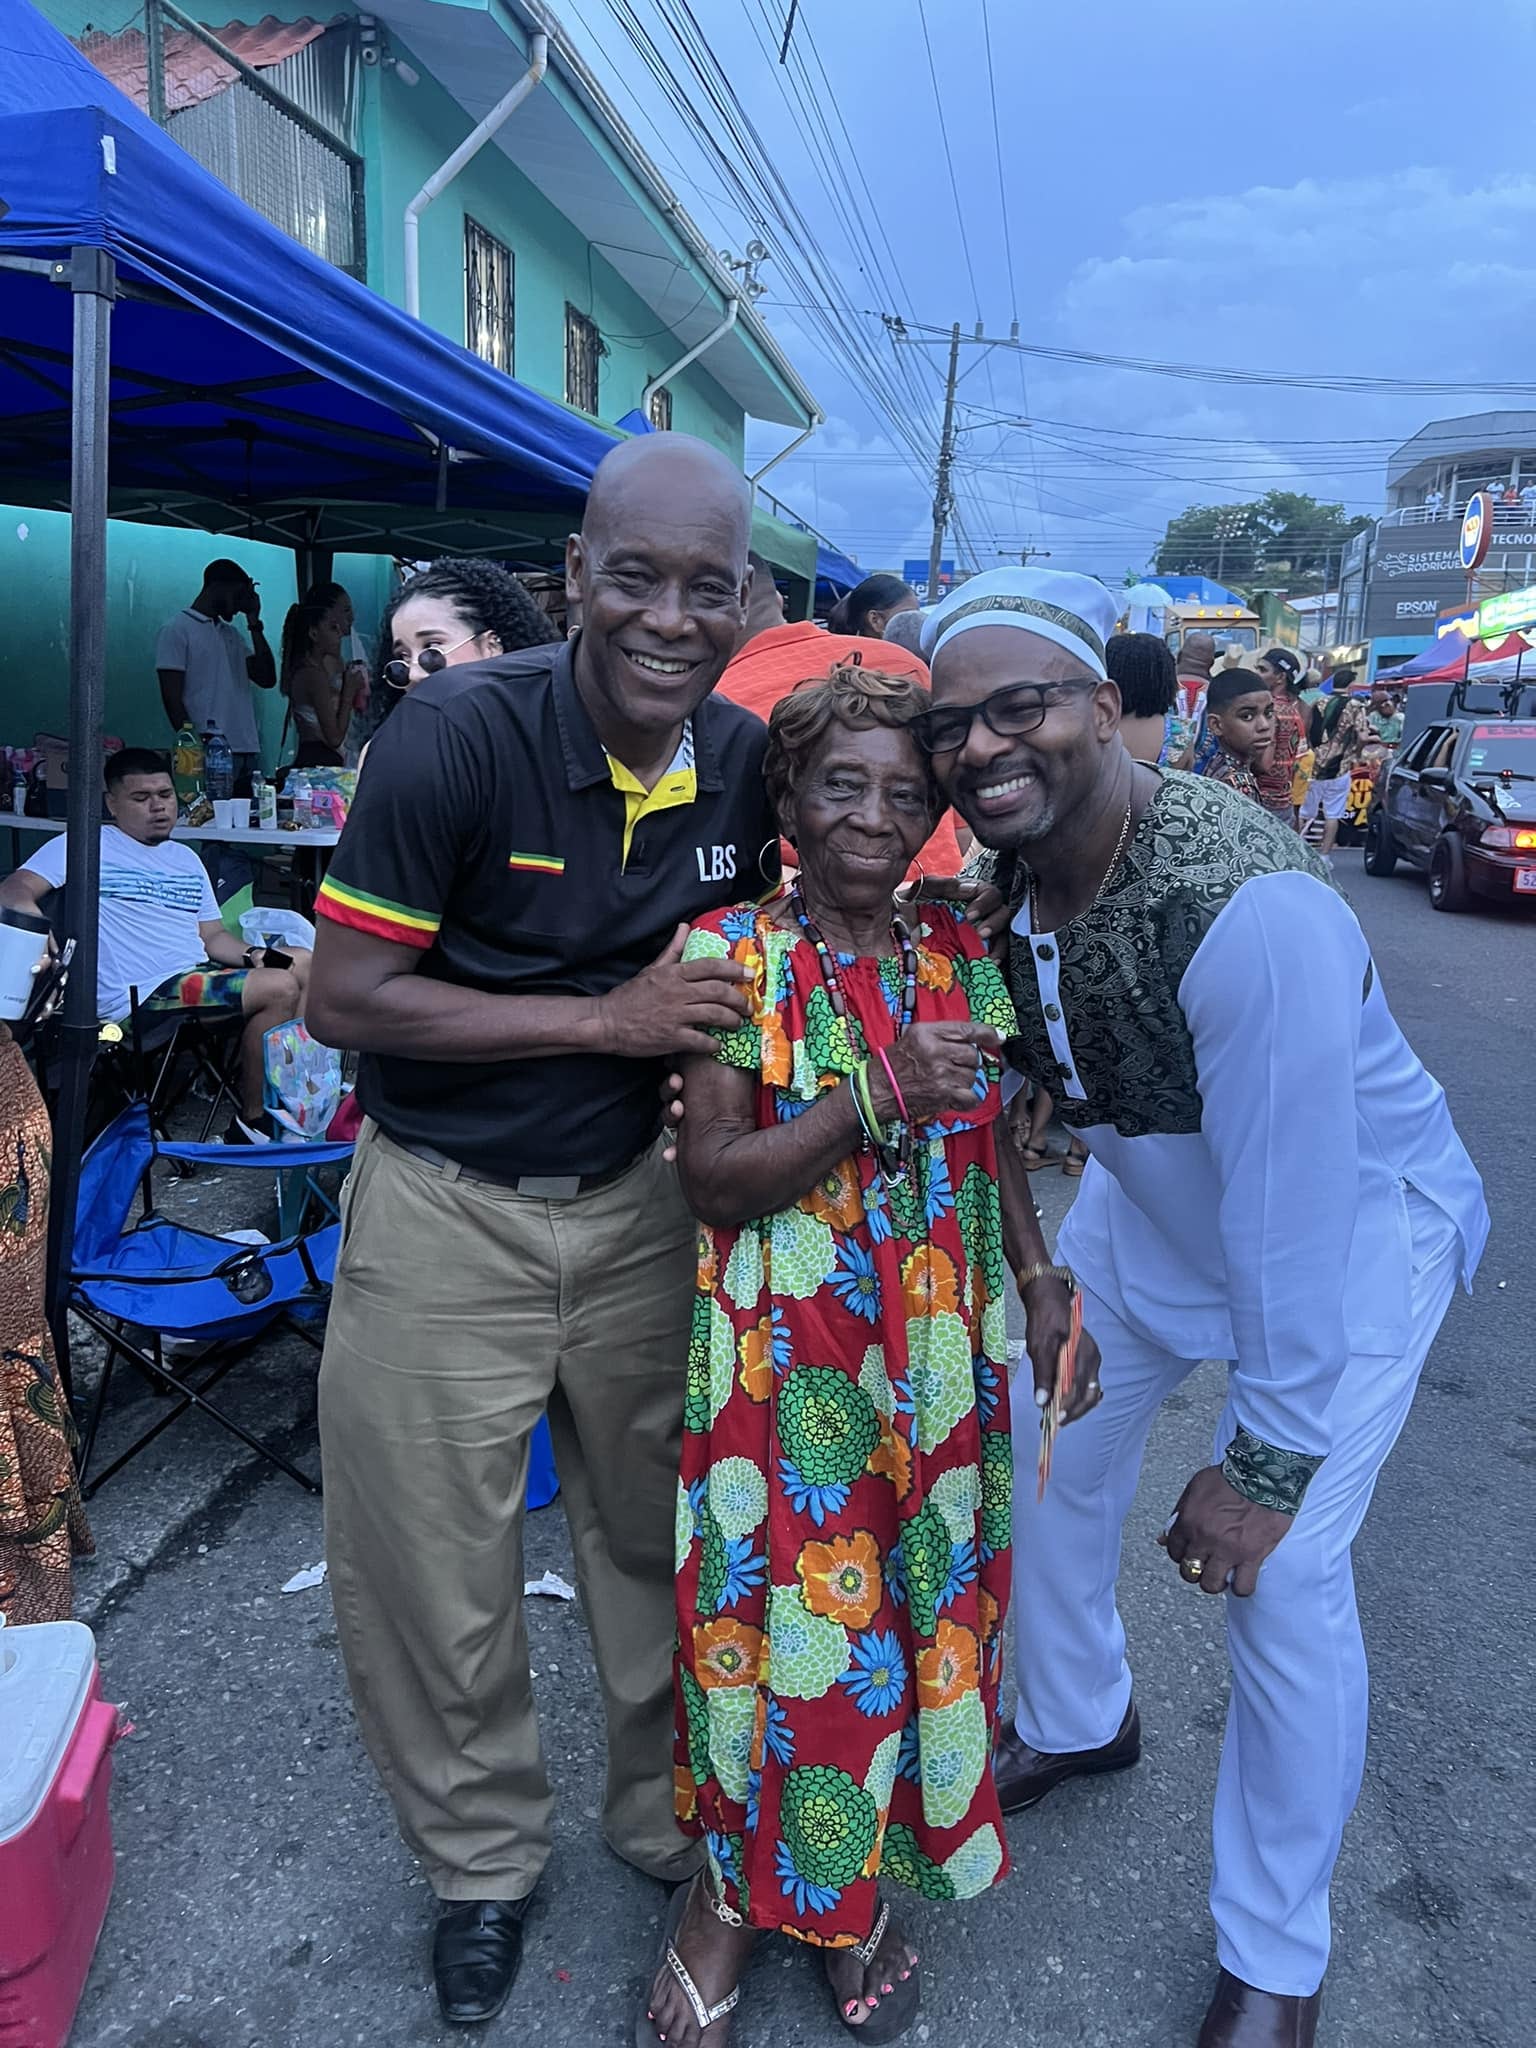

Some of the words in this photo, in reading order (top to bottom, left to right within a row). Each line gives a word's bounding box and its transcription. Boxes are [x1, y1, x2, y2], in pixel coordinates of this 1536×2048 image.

[1491, 534, 1536, 545] TECNO
[1396, 600, 1437, 614] EPSON
[696, 844, 736, 882] LBS
